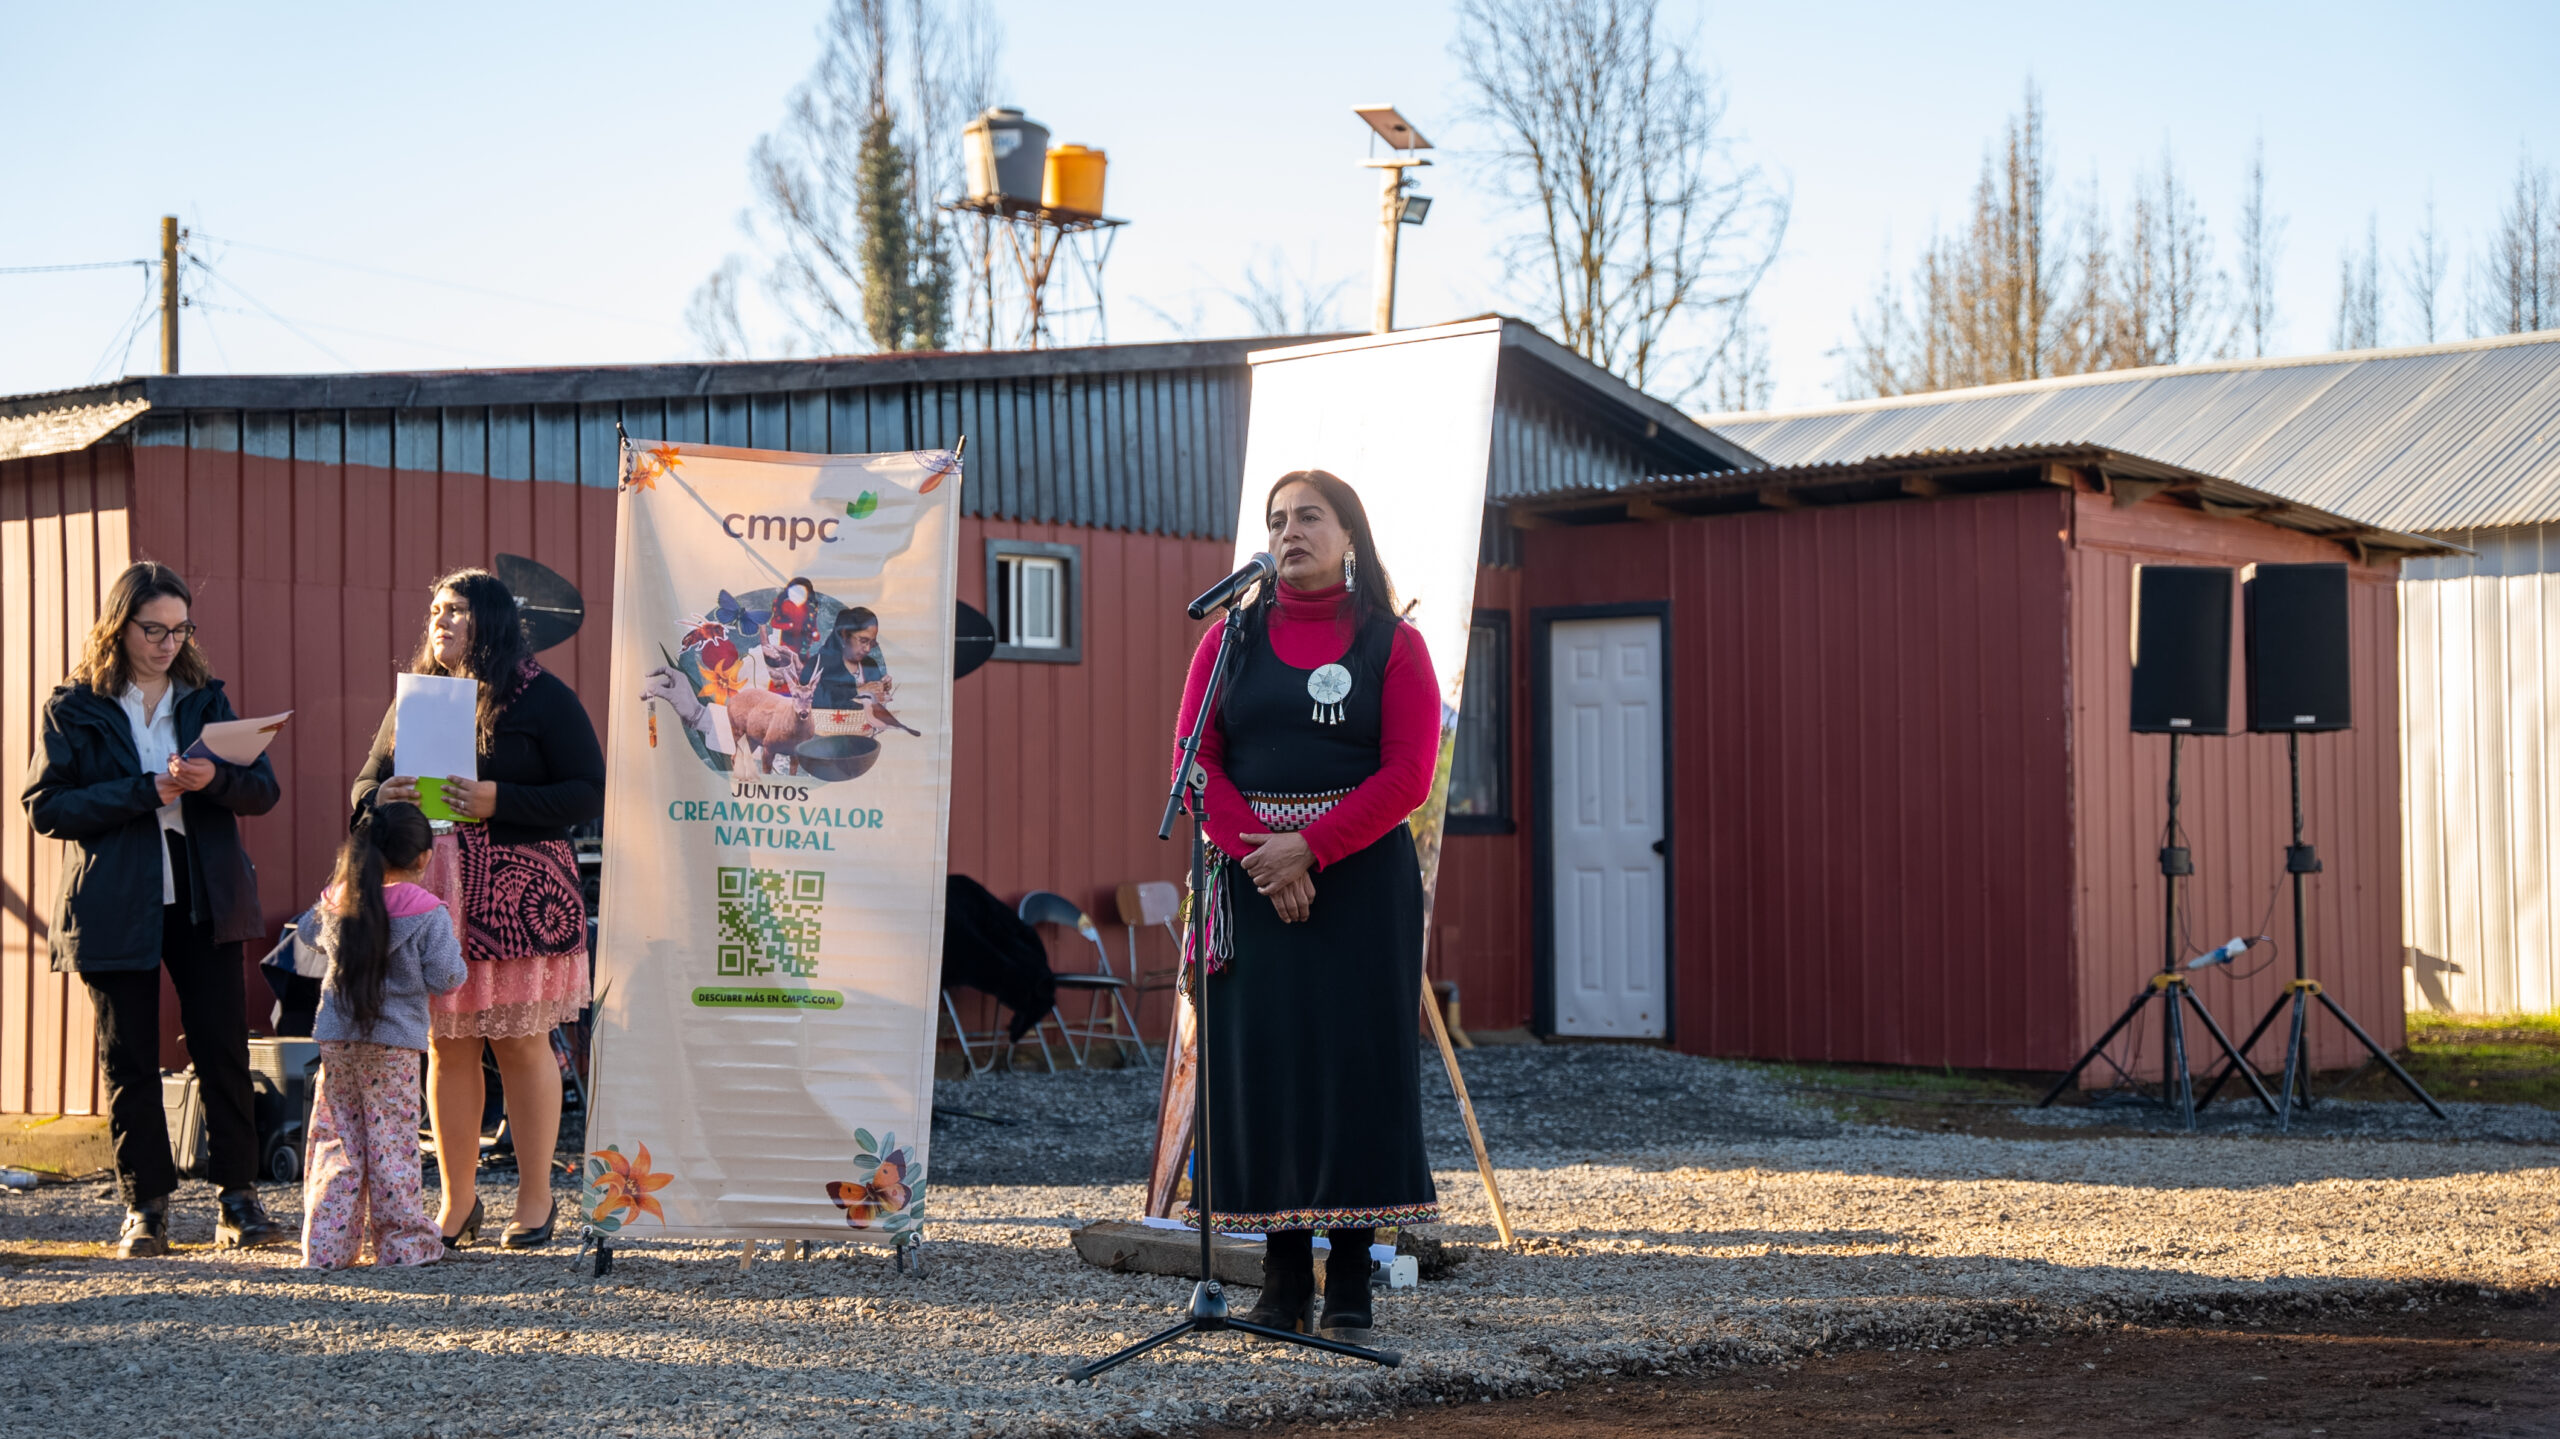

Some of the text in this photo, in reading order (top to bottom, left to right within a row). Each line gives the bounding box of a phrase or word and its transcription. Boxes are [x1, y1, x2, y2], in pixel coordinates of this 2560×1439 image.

[722, 513, 840, 551] cmpc
[732, 783, 809, 801] JUNTOS
[668, 800, 884, 829] CREAMOS VALOR
[714, 825, 835, 851] NATURAL
[698, 991, 836, 1005] DESCUBRE MÁS EN CMPC.COM
